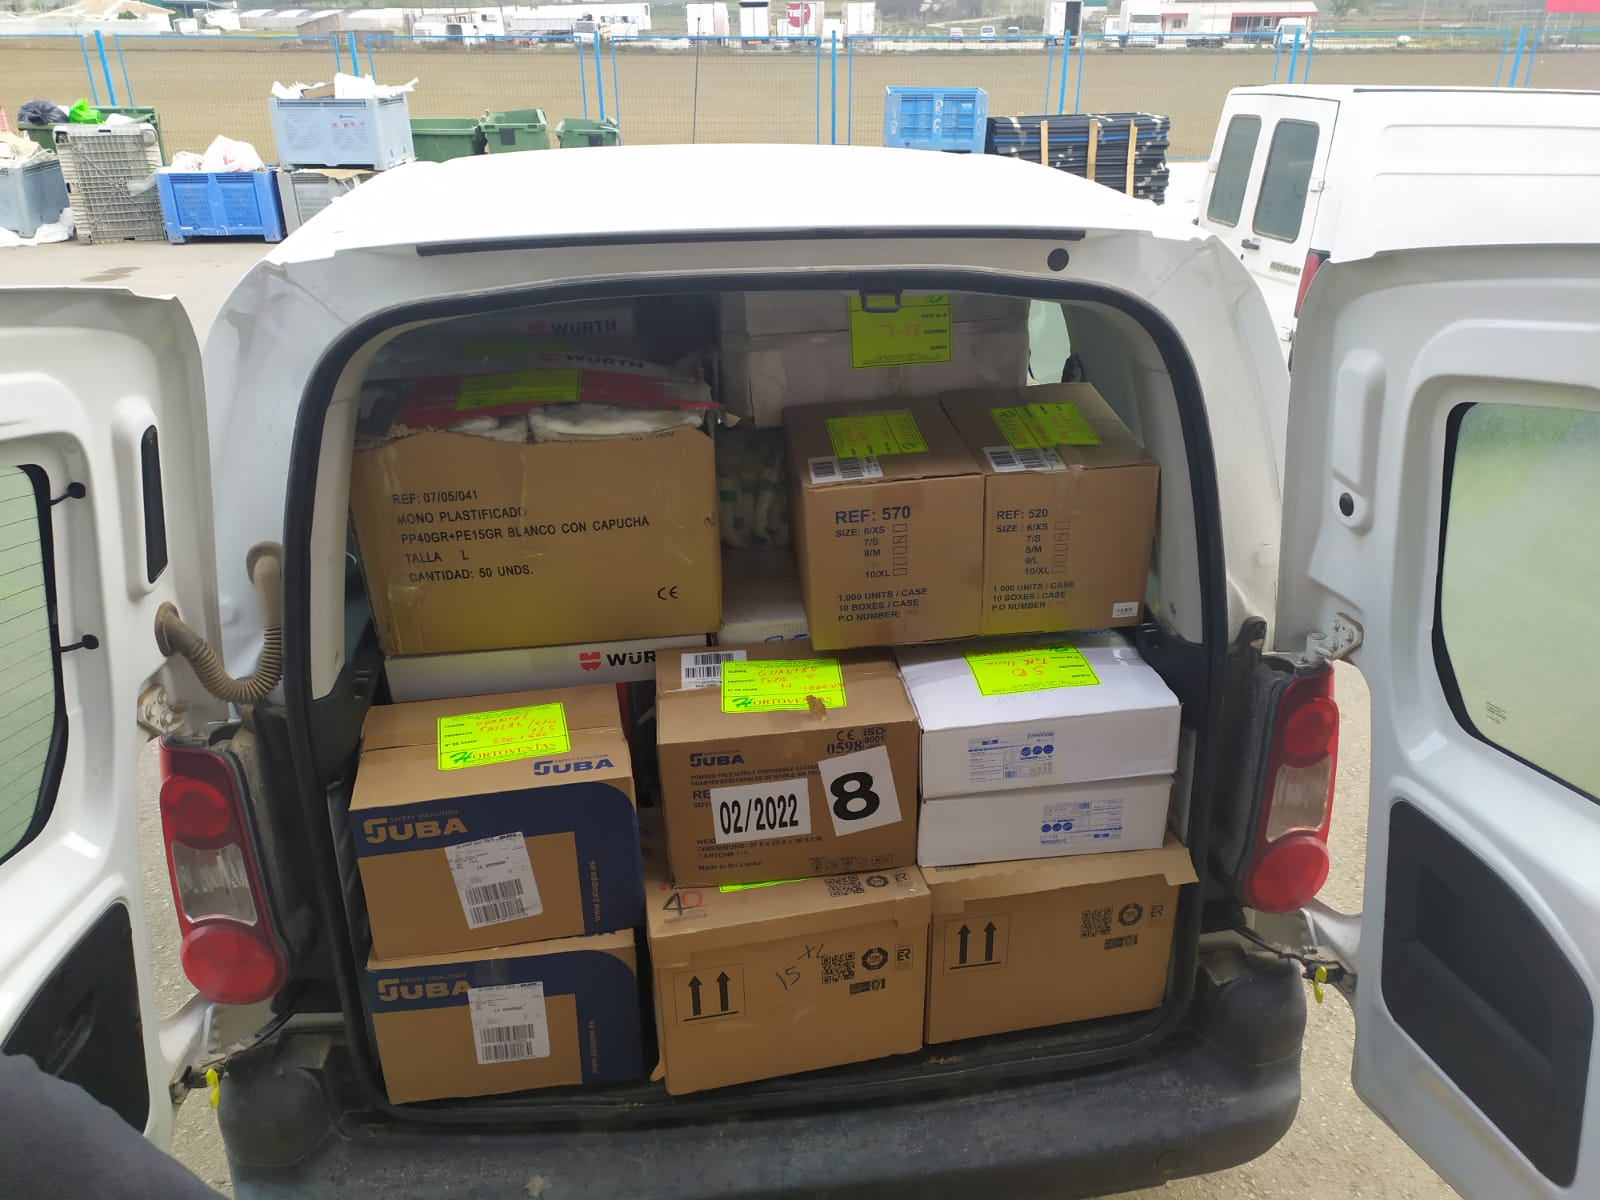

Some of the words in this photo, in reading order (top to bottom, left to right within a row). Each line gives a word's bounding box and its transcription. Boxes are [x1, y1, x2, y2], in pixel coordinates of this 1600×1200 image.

[392, 493, 420, 505] REF:
[422, 489, 478, 504] 07/05/041
[397, 512, 434, 526] MONO
[439, 506, 528, 523] PLASTIFICADO
[835, 509, 876, 524] REF:
[882, 505, 911, 520] 570
[996, 509, 1025, 520] REF:
[1028, 508, 1049, 519] 520
[401, 528, 503, 545] PP40GR+PE15GR
[507, 521, 557, 538] BLANCO
[561, 521, 587, 534] CON
[592, 515, 650, 532] CAPUCHA
[863, 526, 886, 535] 6/XS
[1026, 523, 1049, 532] 6/XS
[864, 537, 879, 546] 7/S
[1025, 534, 1041, 543] 7/S
[864, 548, 881, 557] 8/M
[1025, 545, 1043, 554] 8/M
[405, 551, 442, 564] TALLA
[459, 549, 470, 561] L
[1024, 556, 1040, 565] 9/L
[408, 568, 475, 583] CANTIDAD:
[479, 567, 493, 578] 50
[497, 564, 534, 577] UNDS.
[865, 569, 891, 579] 10/XL
[1024, 566, 1050, 576] 10/XL
[1017, 583, 1043, 591] UNITS
[1050, 581, 1074, 589] CASE
[657, 586, 680, 600] CE
[865, 591, 893, 599] UNITS
[901, 588, 928, 597] CASE
[1004, 594, 1035, 602] BOXES
[1042, 591, 1066, 599] CASE
[839, 604, 849, 612] 10
[851, 602, 885, 611] BOXES
[892, 599, 920, 608] CASE
[606, 650, 657, 666] WÜR
[864, 727, 885, 737] ISO
[864, 736, 885, 744] 9001
[826, 740, 862, 755] 0598
[690, 752, 745, 768] JUBA
[534, 758, 614, 776] JUBA
[693, 789, 711, 800] RE
[830, 771, 880, 821] 8
[719, 793, 800, 835] 02/2022
[363, 817, 468, 844] JUBA
[377, 978, 472, 1002] JUBA
